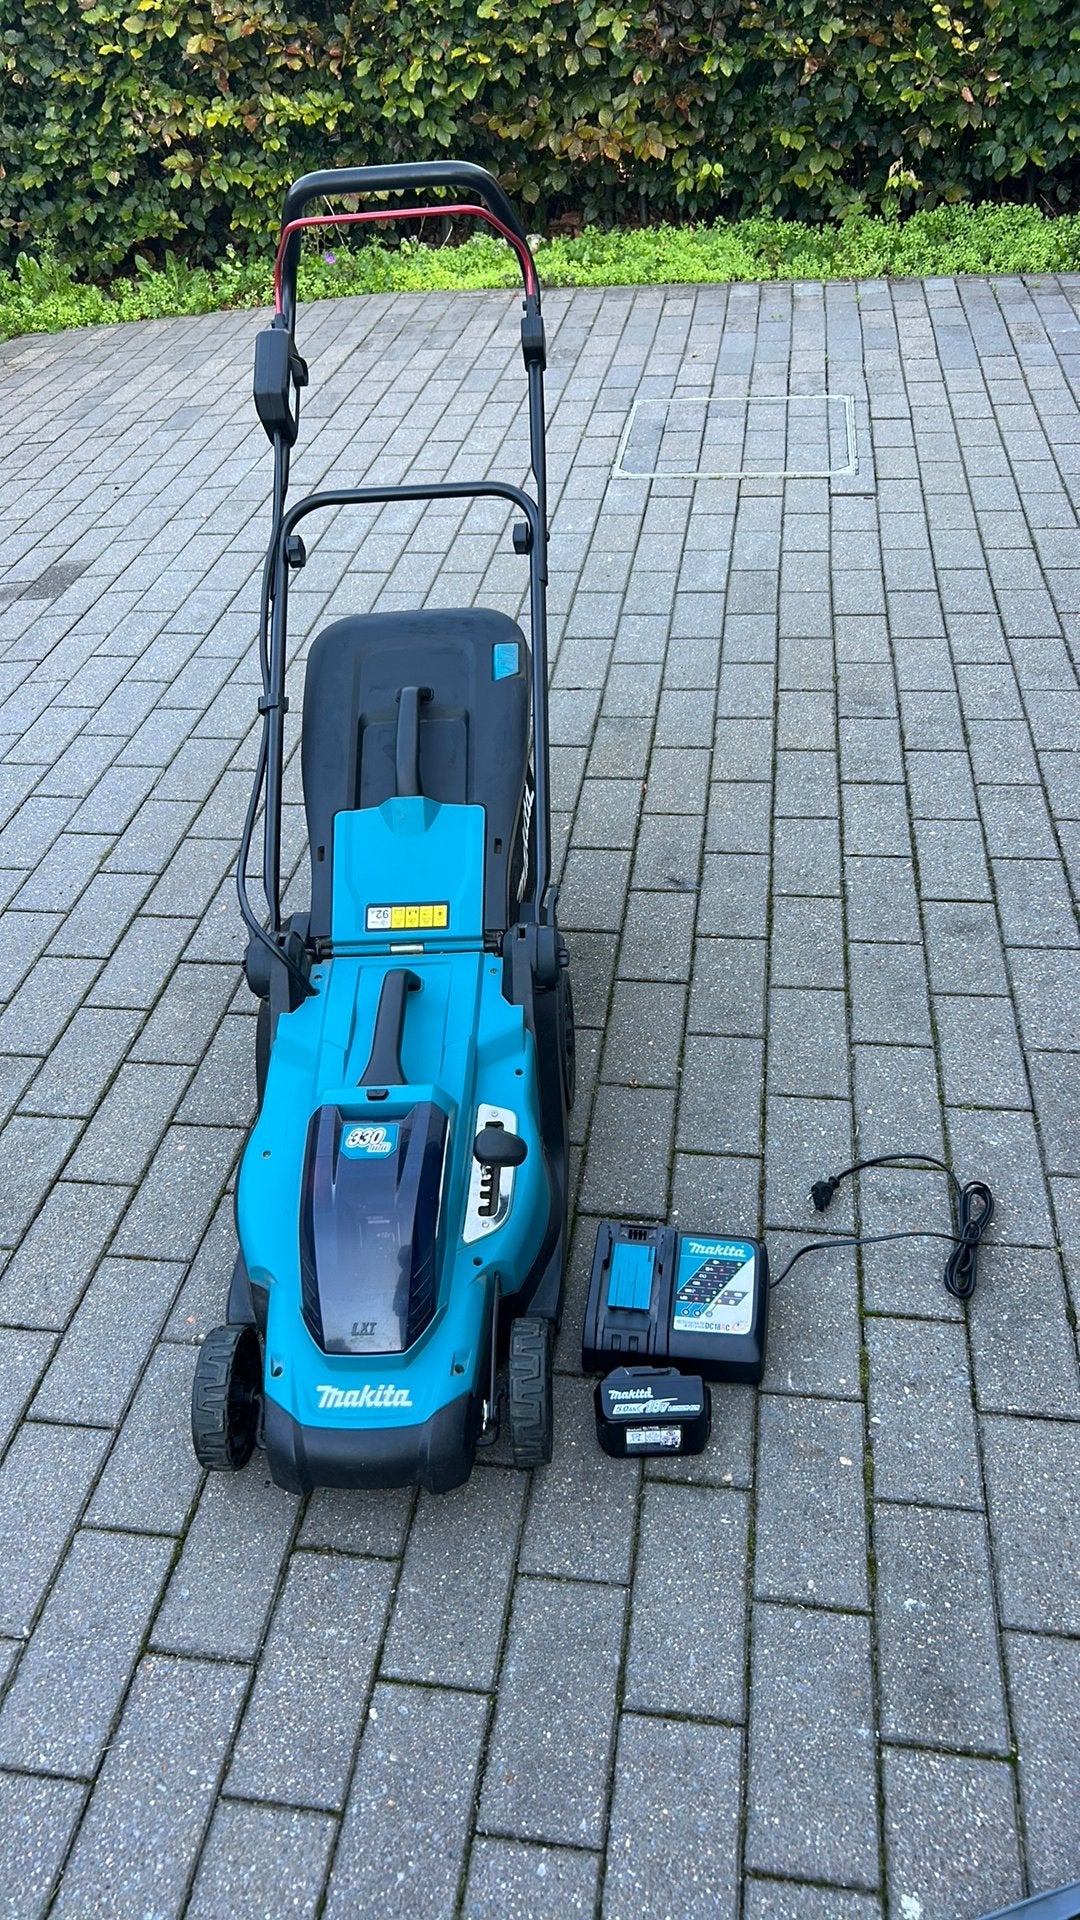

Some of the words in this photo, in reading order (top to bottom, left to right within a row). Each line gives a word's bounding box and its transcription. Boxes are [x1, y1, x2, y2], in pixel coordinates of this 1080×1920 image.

[347, 1128, 385, 1146] 330
[368, 1143, 391, 1152] mm
[351, 1322, 377, 1336] LXT
